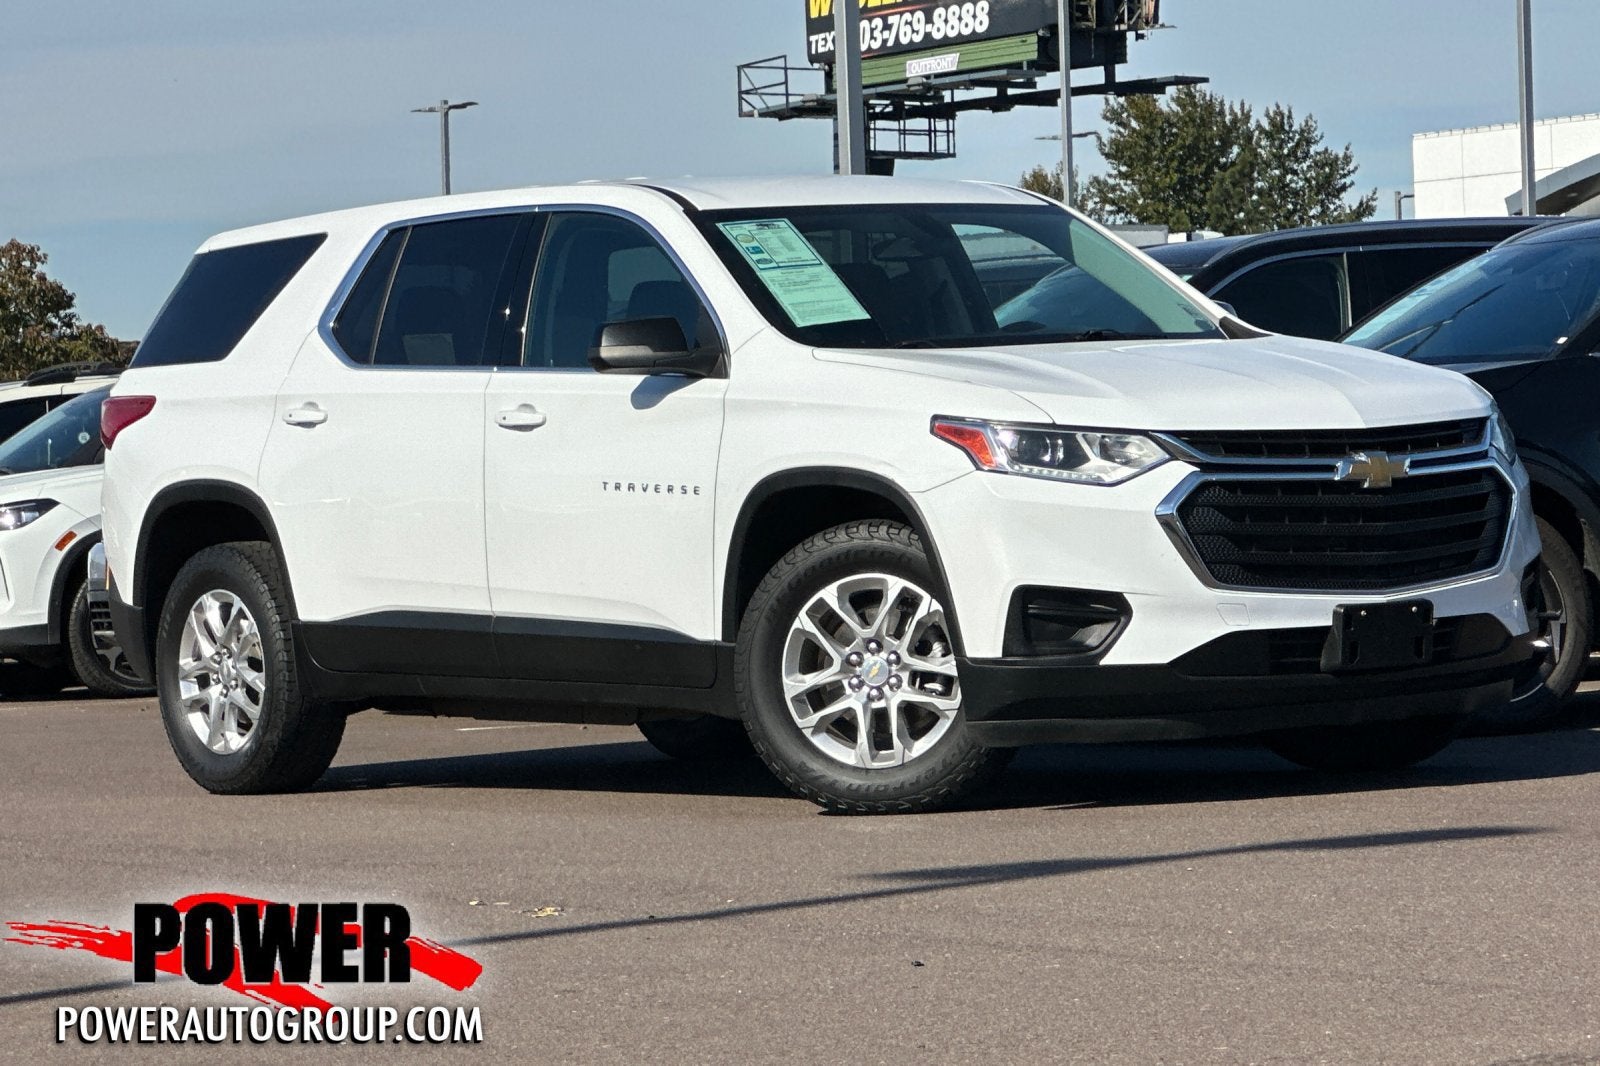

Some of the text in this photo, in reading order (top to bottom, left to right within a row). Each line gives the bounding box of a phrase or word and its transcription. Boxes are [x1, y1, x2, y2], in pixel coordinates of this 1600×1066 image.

[809, 31, 836, 55] TEX
[859, 0, 990, 53] 03-769-8888
[911, 59, 954, 74] OUTFRONT
[602, 482, 701, 495] TRAVERSE
